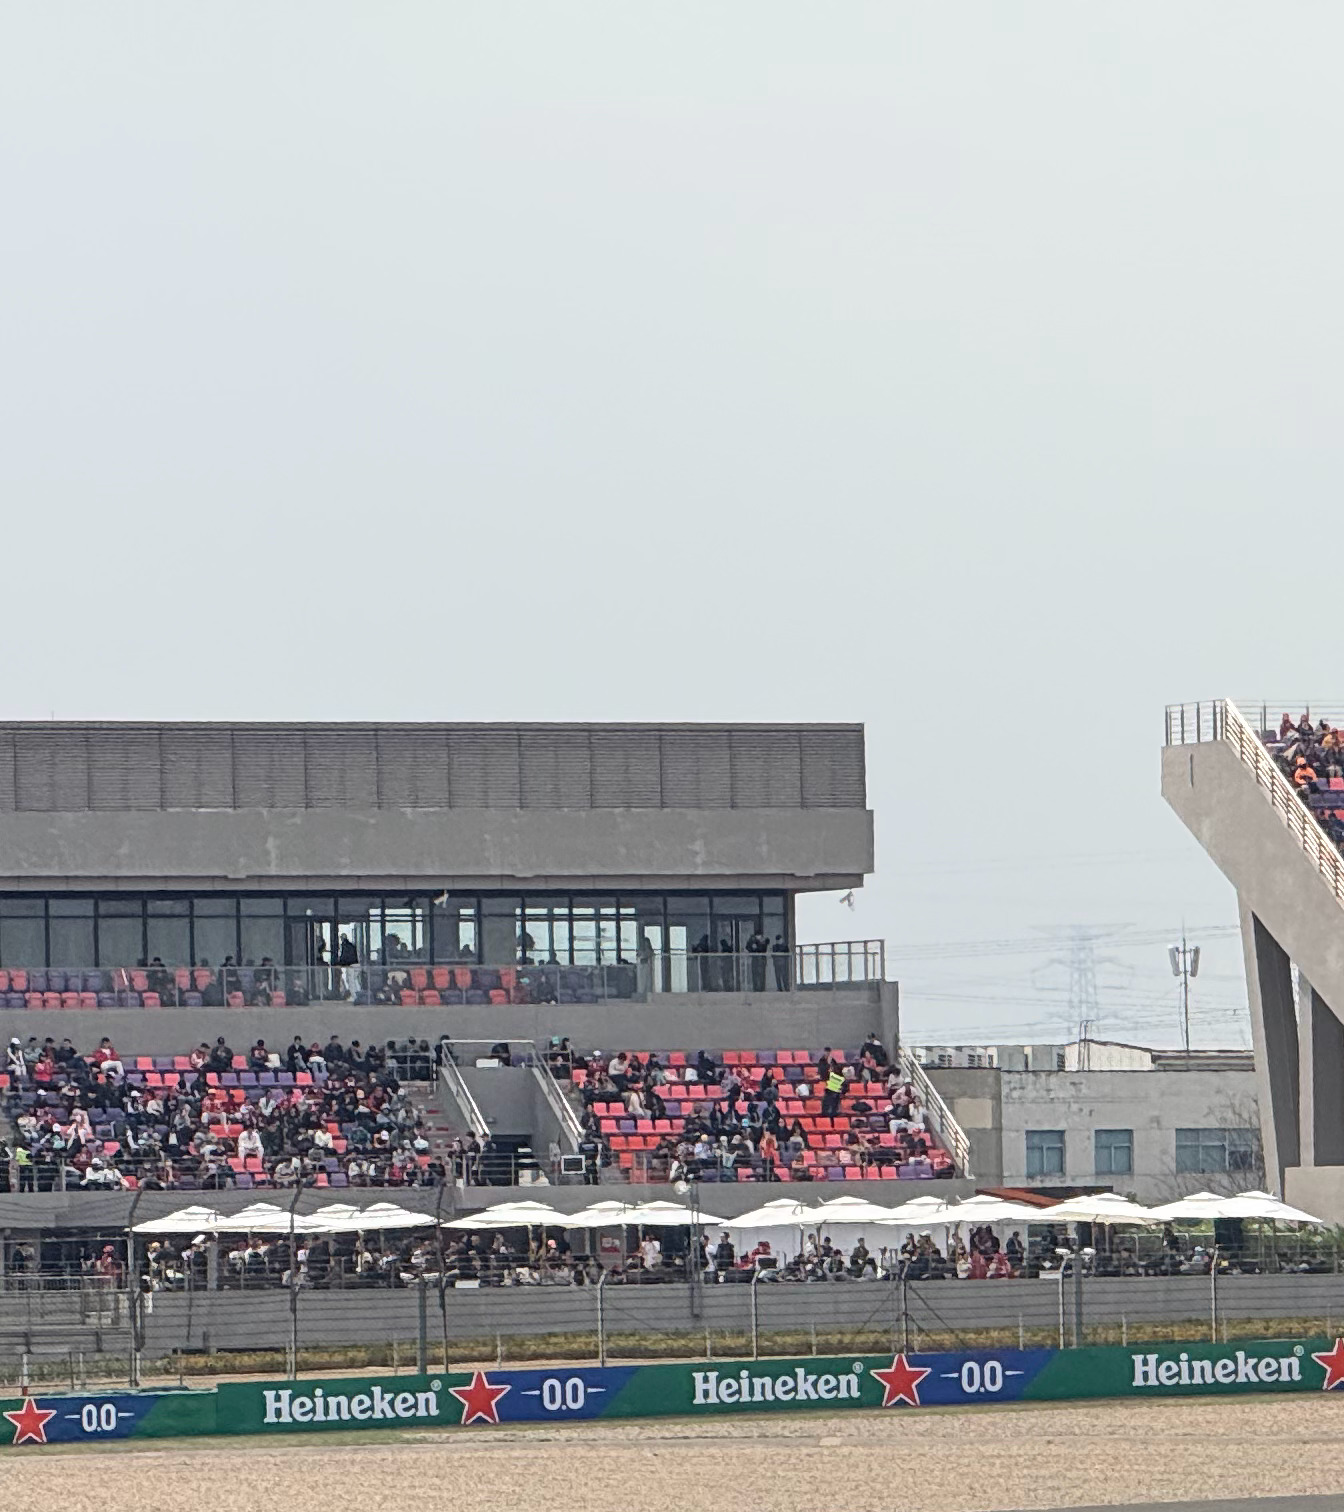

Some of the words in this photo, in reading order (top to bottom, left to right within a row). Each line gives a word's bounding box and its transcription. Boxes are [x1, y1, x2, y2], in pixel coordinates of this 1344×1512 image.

[692, 1368, 860, 1405] Heineken
[1131, 1351, 1302, 1387] Heineken
[263, 1386, 439, 1423] Heineken
